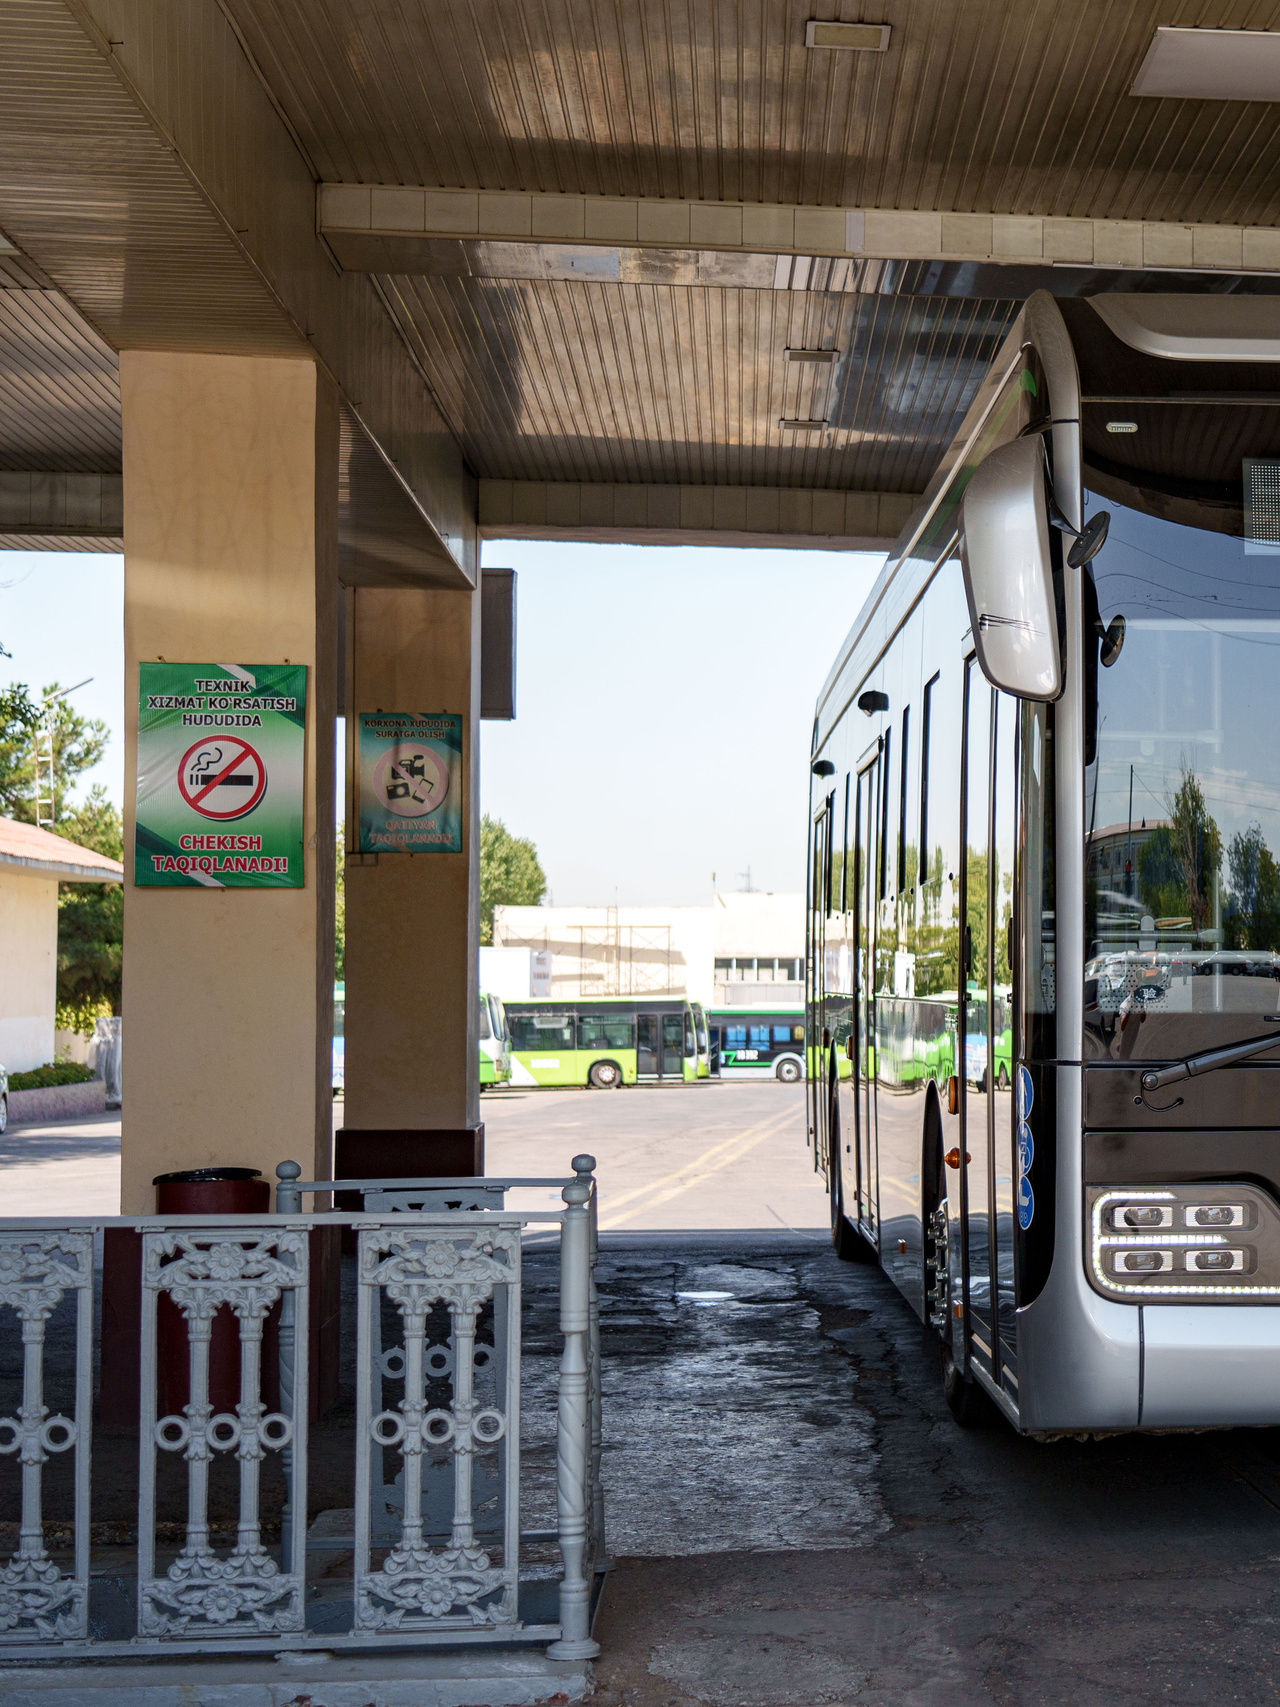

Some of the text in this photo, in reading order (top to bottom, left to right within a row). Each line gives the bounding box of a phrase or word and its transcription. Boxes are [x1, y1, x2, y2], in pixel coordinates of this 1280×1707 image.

[196, 680, 250, 692] TEXNIK
[148, 697, 204, 709] XIZMAT
[182, 714, 262, 727] HUDUDIDA
[364, 720, 456, 728] KORXONA XUDUDIDA
[179, 835, 261, 850] CHEKISH
[152, 856, 288, 874] TAQIQLANADI!
